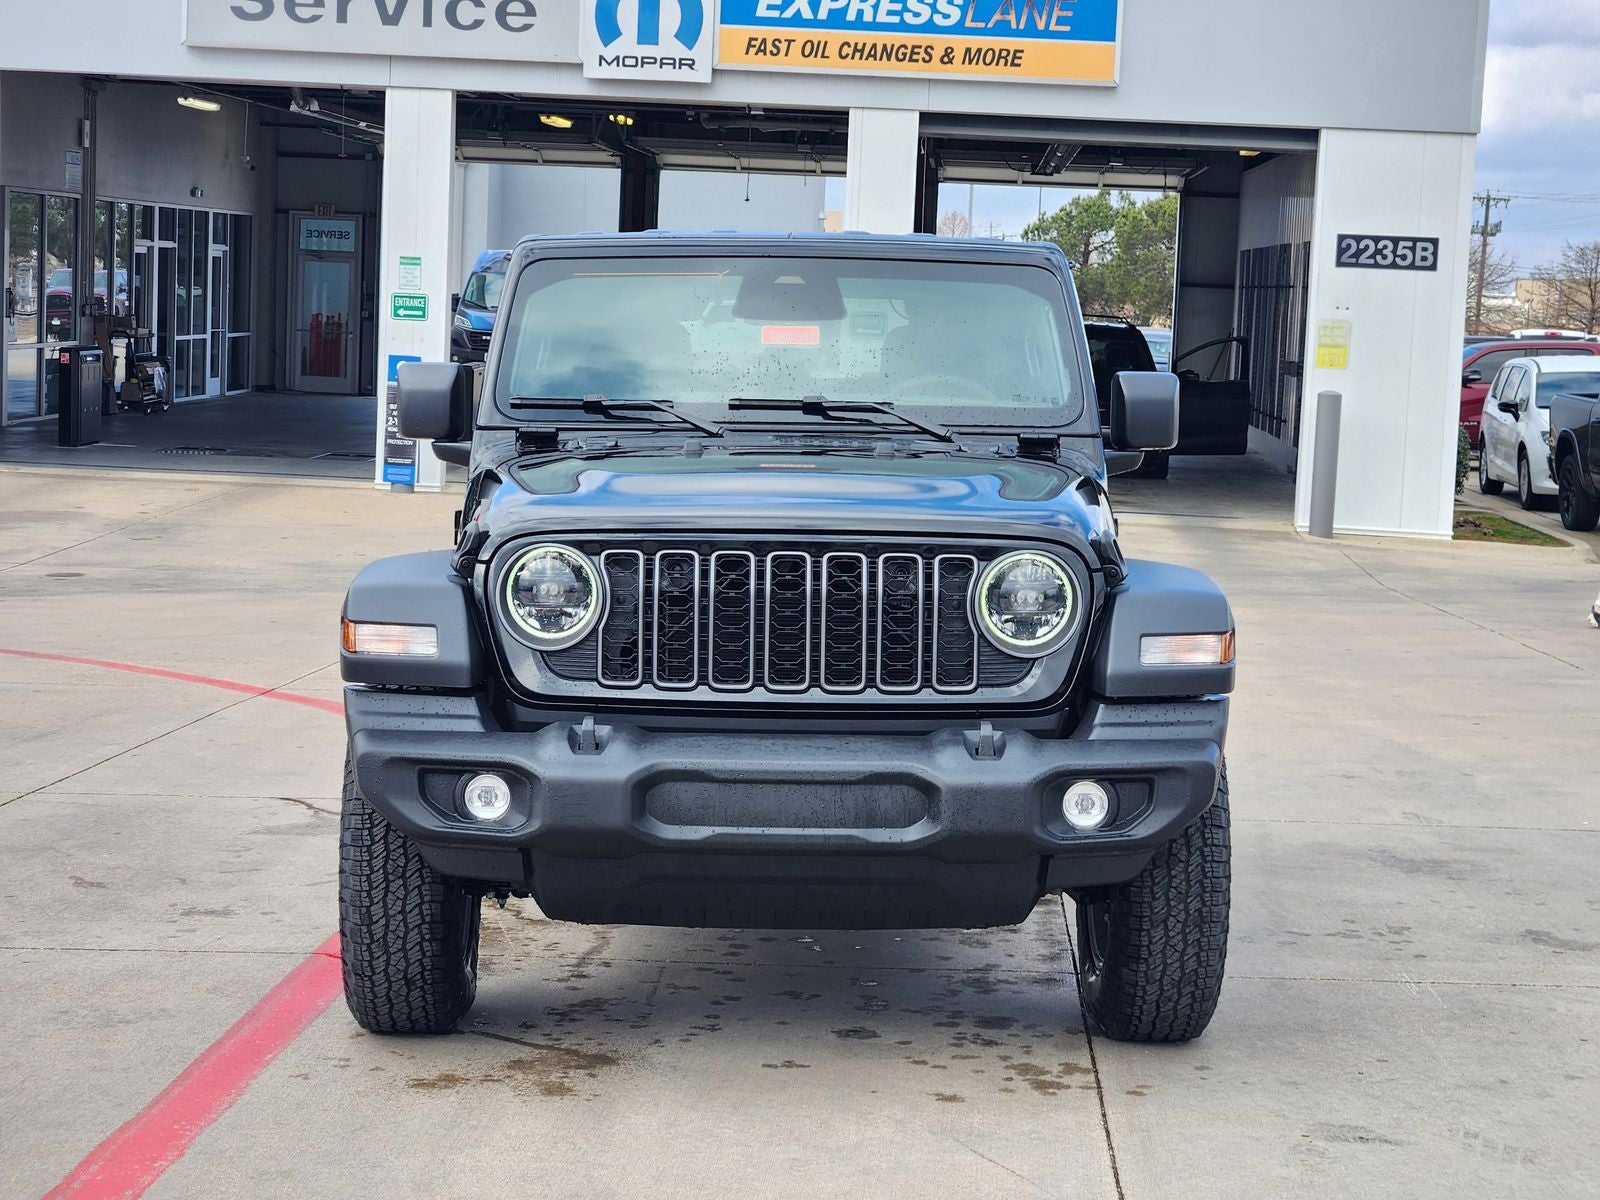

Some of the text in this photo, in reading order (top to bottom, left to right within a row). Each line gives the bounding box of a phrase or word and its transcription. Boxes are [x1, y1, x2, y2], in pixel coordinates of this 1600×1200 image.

[599, 54, 696, 71] MOPAR
[745, 37, 1024, 67] FAST OIL CHANGES & MORE
[1339, 238, 1435, 267] 2235B
[394, 297, 426, 307] ENTRANCE
